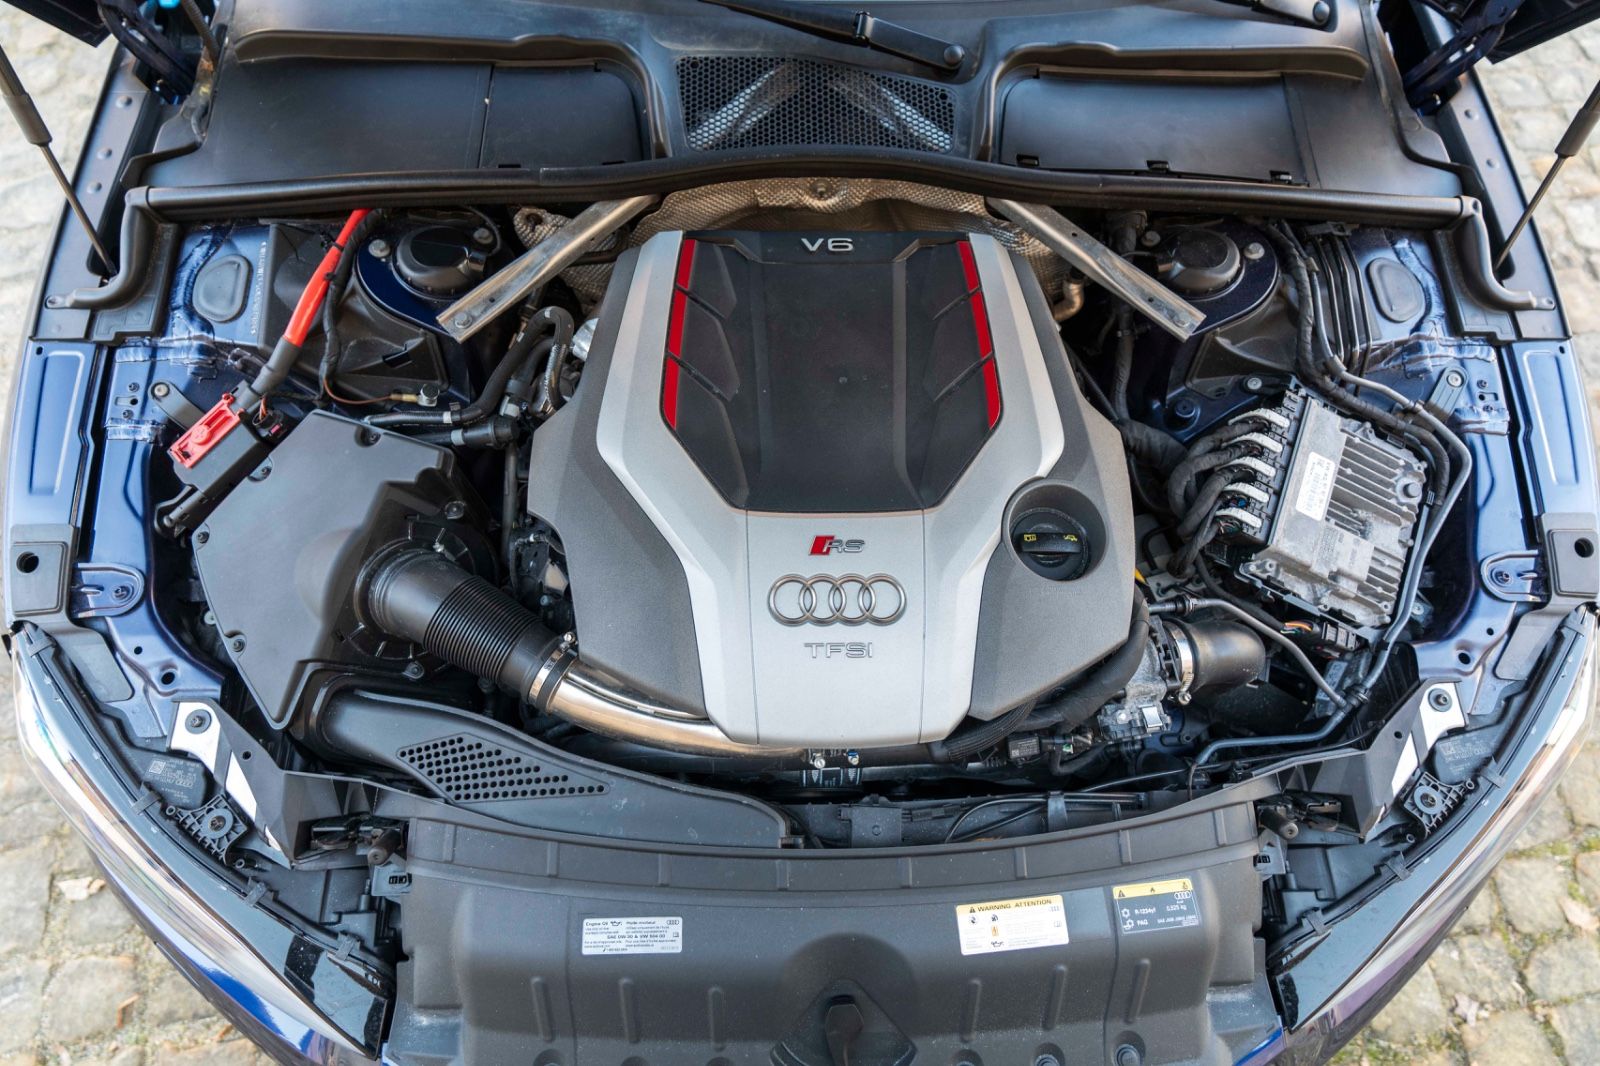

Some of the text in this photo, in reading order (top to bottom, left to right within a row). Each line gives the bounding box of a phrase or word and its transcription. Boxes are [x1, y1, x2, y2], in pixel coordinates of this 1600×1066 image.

[801, 238, 854, 251] V6
[817, 537, 865, 554] RS
[804, 641, 872, 659] TFSI
[977, 899, 1052, 912] WARNING ATTENTION
